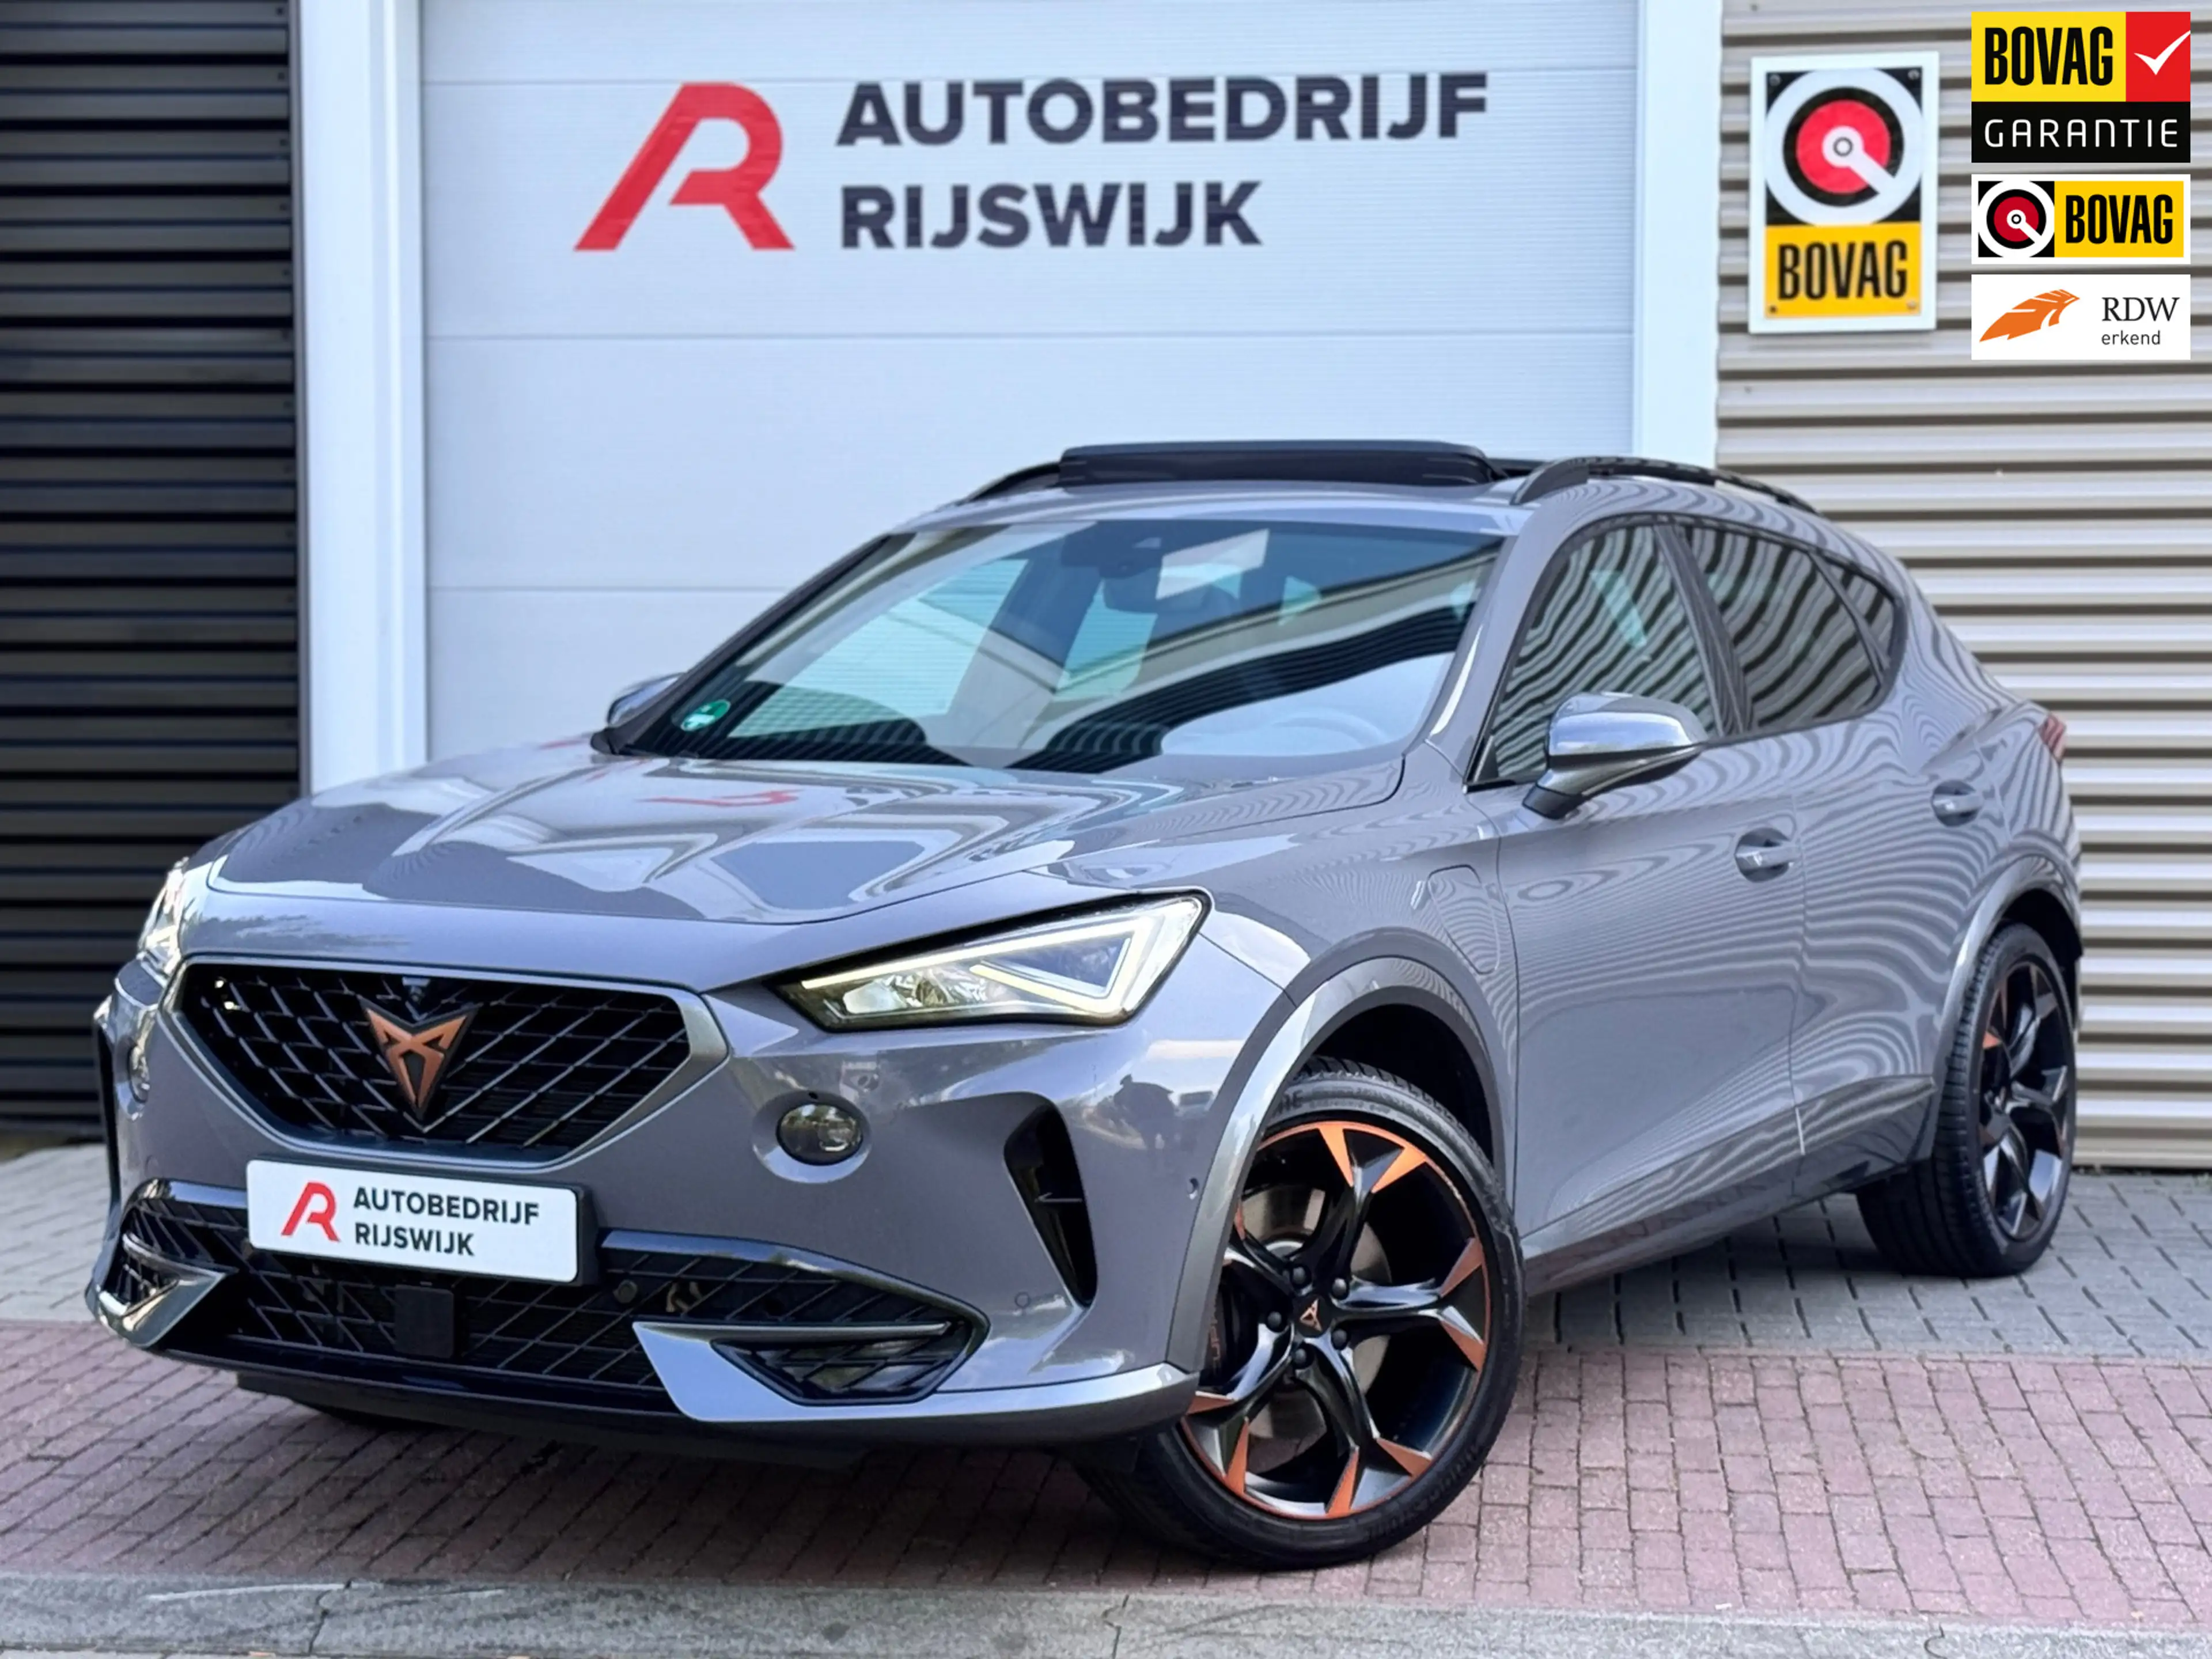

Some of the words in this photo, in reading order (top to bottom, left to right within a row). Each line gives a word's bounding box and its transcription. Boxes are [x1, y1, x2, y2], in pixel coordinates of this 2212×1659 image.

[836, 72, 1487, 146] AUTOBEDRIJF
[842, 181, 1262, 248] RIJSWIJK
[1778, 240, 1907, 301] BOVAG
[354, 1187, 539, 1225] AUTOBEDRIJF
[355, 1222, 474, 1256] RIJSWIJK
